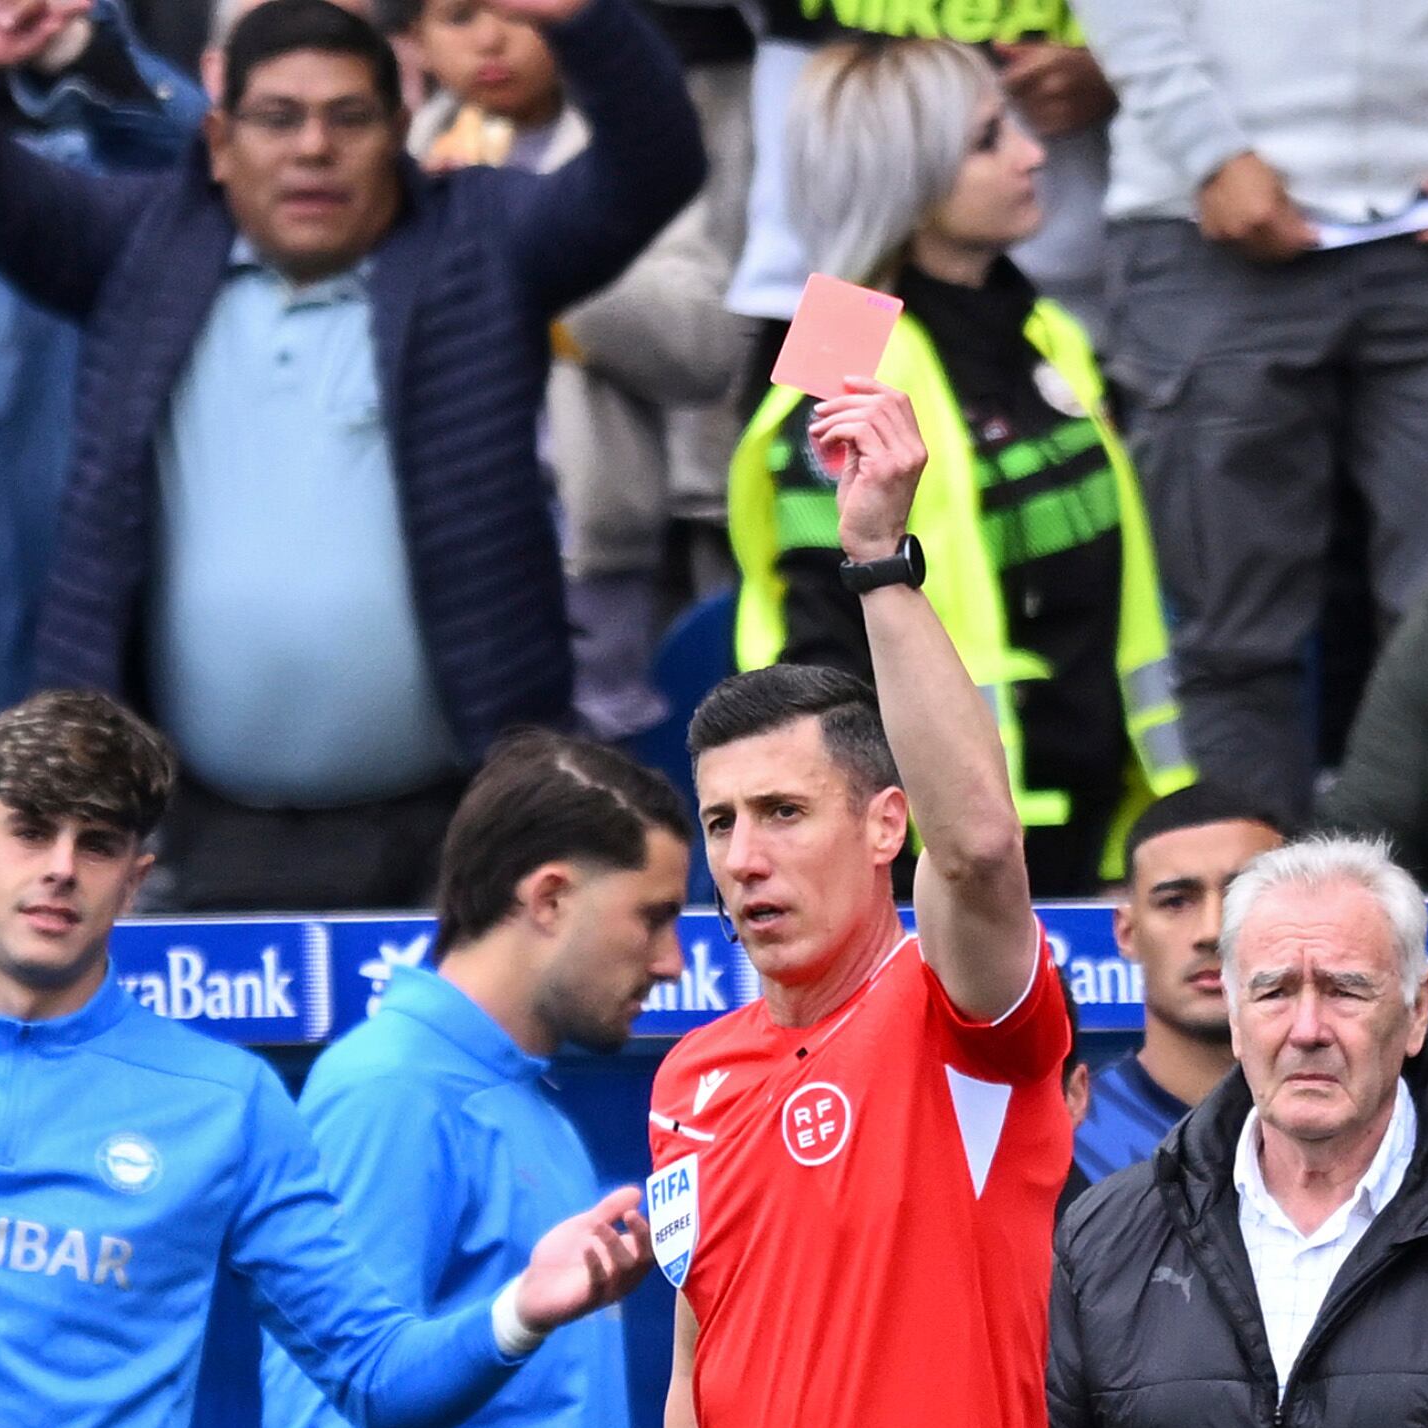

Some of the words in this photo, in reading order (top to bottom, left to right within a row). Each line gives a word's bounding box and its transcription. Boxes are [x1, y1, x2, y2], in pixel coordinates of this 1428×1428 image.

[118, 946, 298, 1020] aBank
[651, 1167, 690, 1212] FIFA
[655, 1212, 691, 1247] REFEREE
